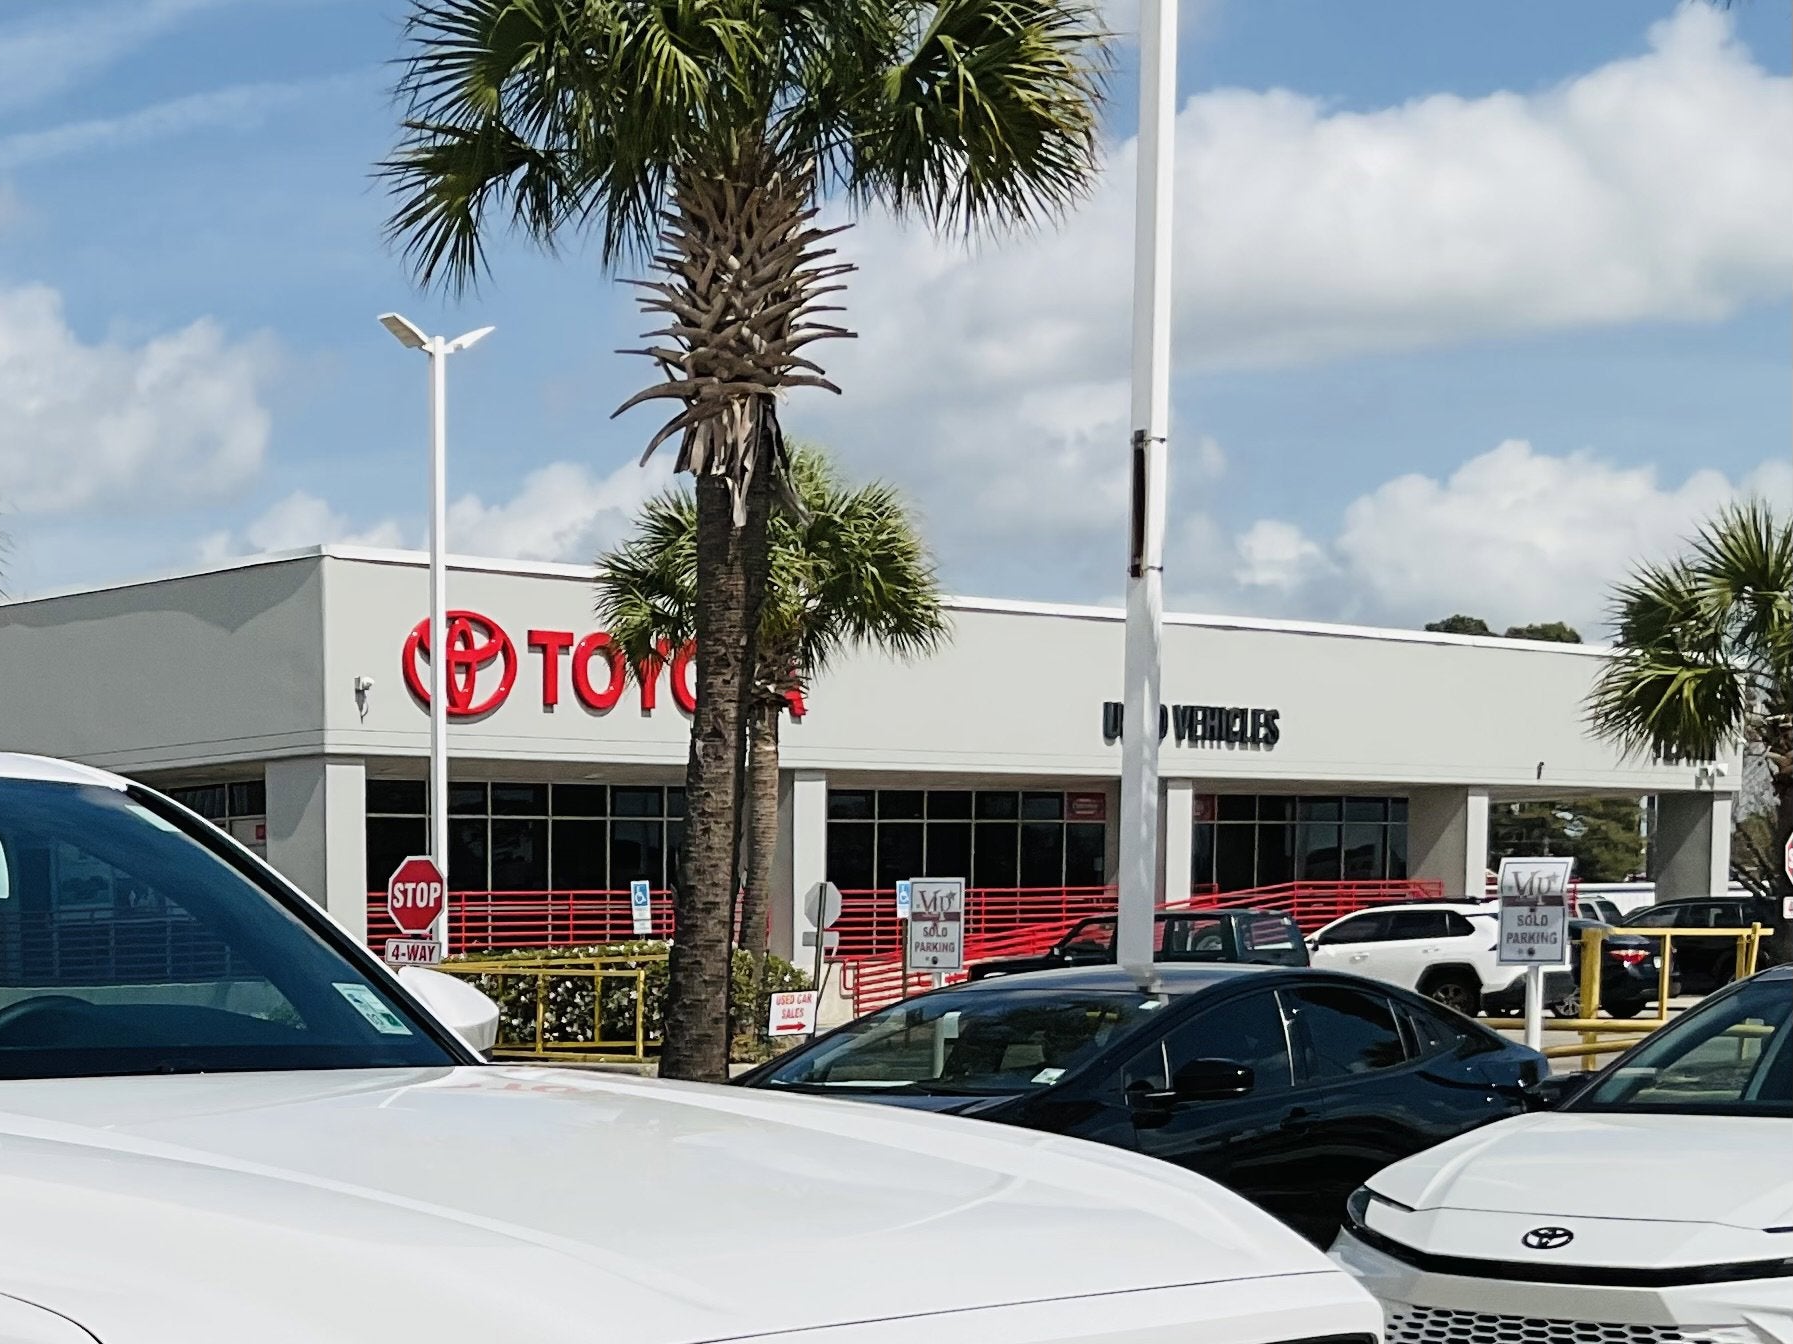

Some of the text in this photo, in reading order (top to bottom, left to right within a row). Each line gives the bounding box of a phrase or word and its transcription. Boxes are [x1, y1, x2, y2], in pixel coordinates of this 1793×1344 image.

[527, 629, 806, 717] TOY
[1172, 704, 1280, 746] VEHICLES
[392, 882, 441, 909] STOP
[1517, 914, 1548, 927] SOLD
[922, 926, 948, 938] SOLD
[1506, 931, 1558, 945] PARKING
[391, 944, 436, 962] 4-WAY
[914, 941, 955, 953] PARKING
[776, 992, 813, 1005] USED CAR
[782, 1007, 804, 1019] SALES
